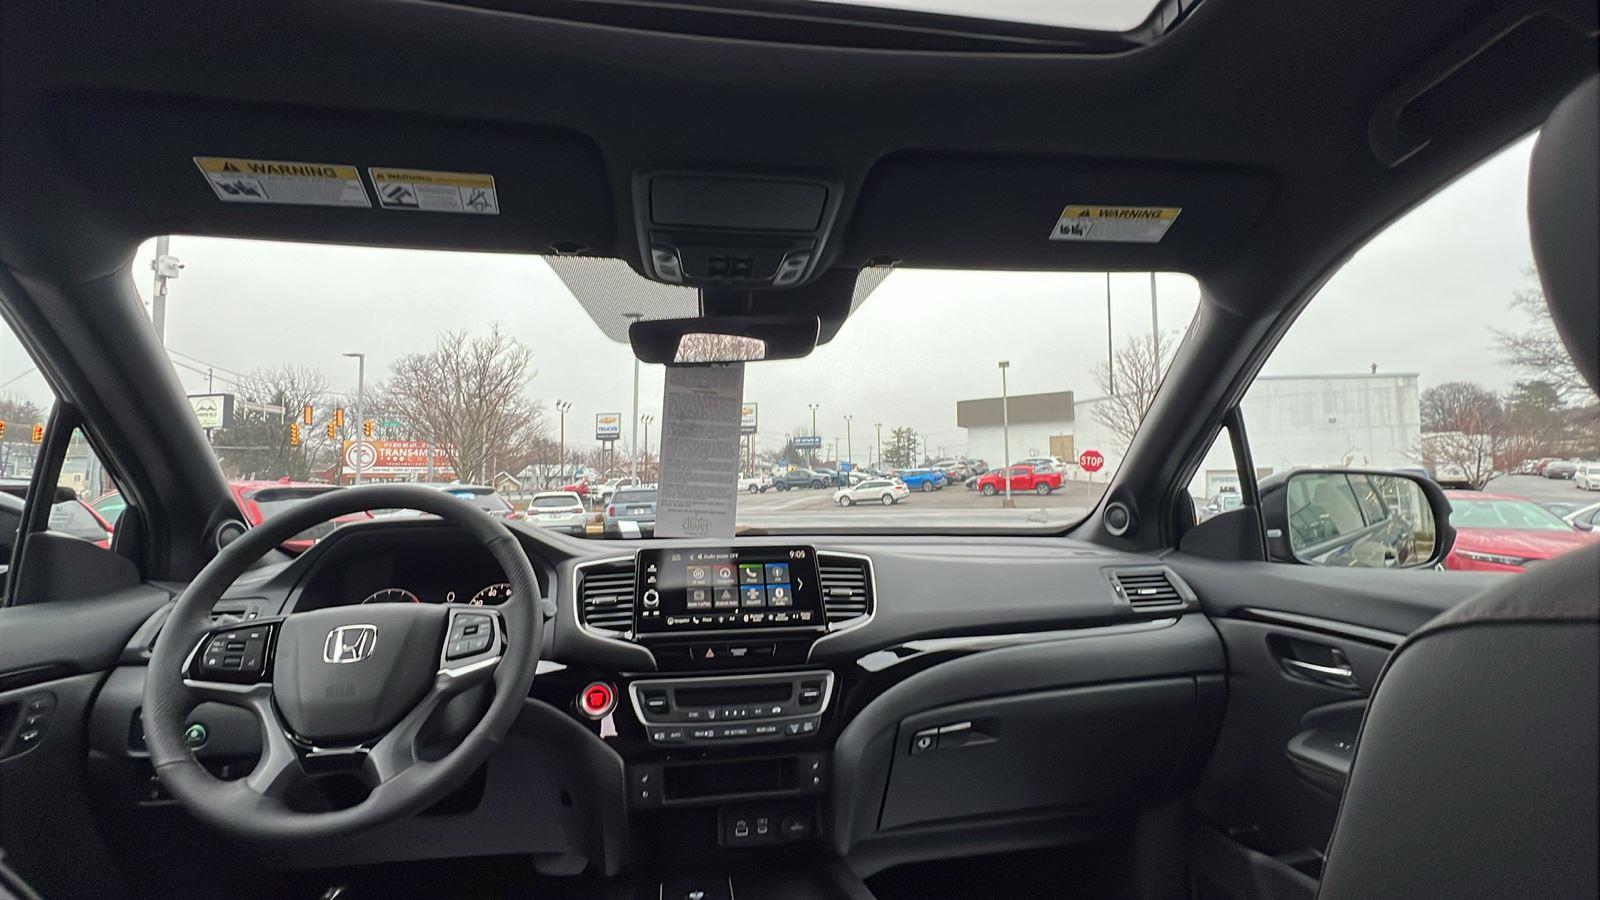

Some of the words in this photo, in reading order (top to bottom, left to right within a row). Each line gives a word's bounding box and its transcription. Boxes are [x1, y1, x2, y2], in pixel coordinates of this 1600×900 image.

[247, 162, 337, 178] WARNING
[386, 172, 432, 182] WARNING
[1099, 208, 1163, 219] WARNING
[1080, 455, 1103, 467] STOP
[789, 550, 805, 559] 9:05
